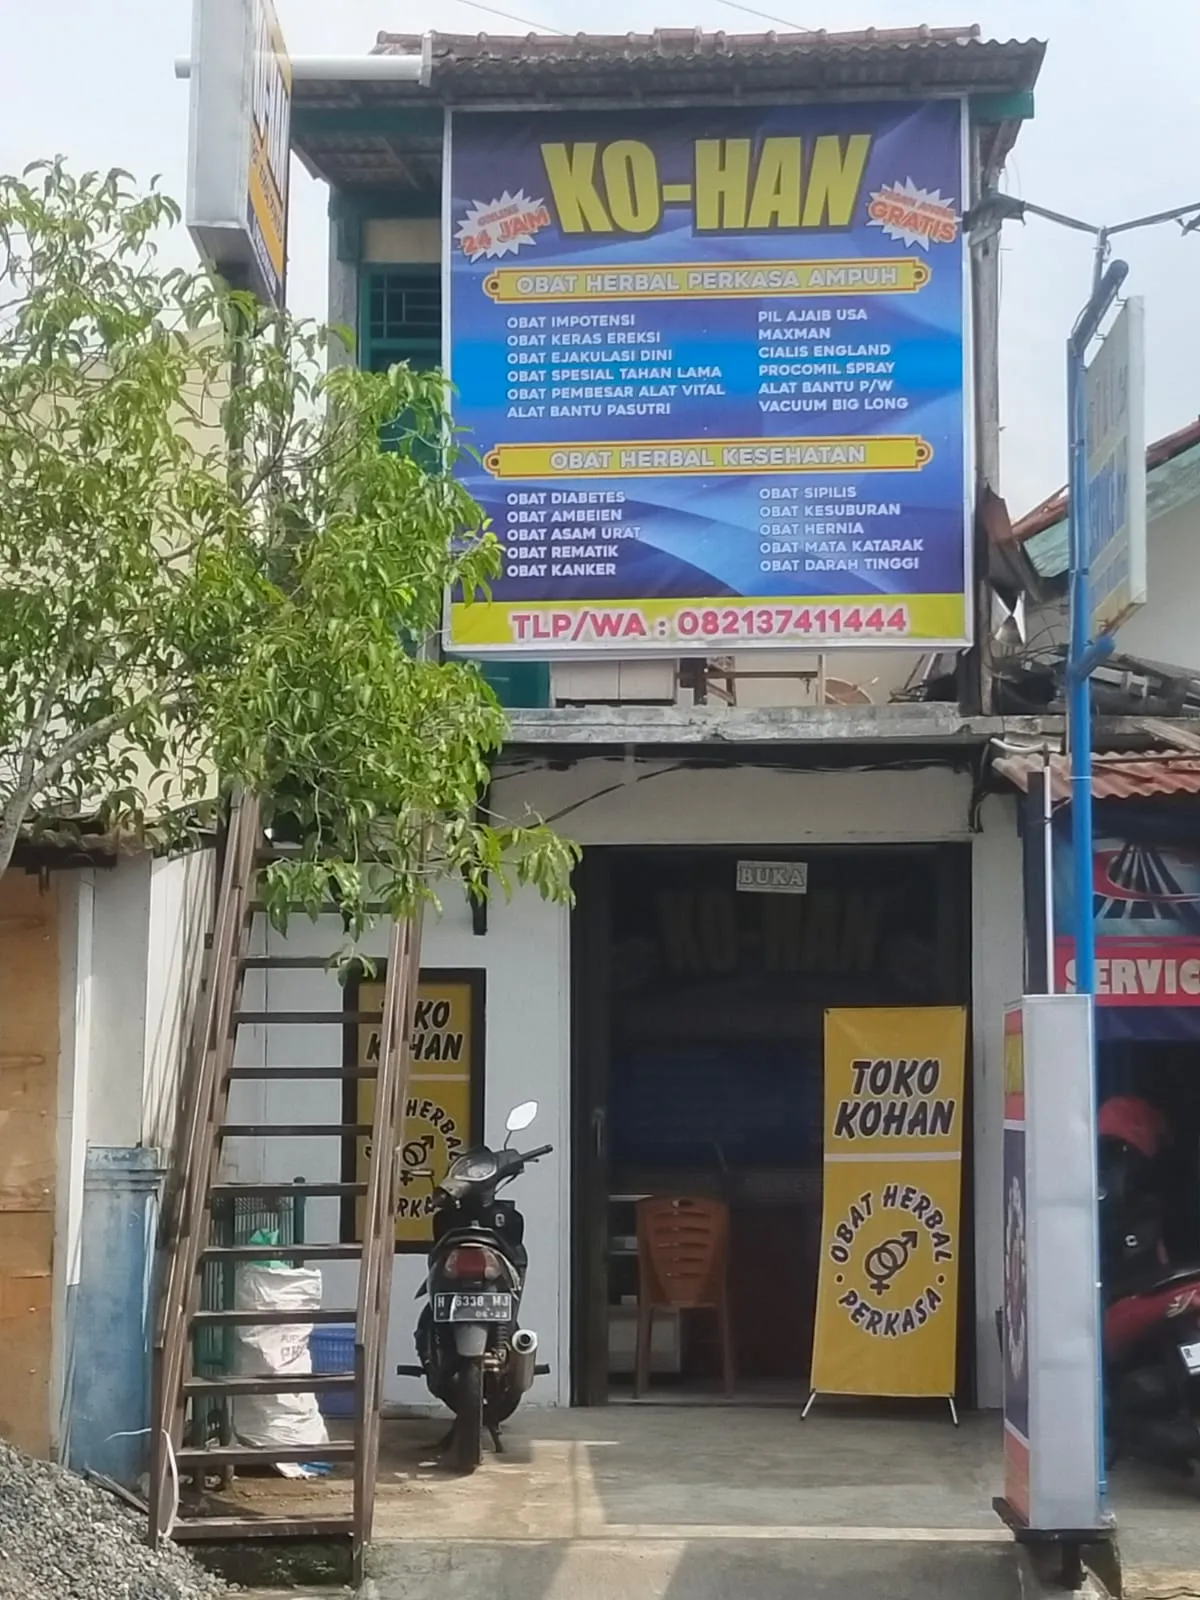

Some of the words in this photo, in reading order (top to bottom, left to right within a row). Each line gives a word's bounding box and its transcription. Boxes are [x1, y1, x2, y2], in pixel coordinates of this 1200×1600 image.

[541, 135, 872, 233] KO-HAN
[870, 200, 956, 242] GRATIS
[462, 229, 492, 255] 24
[497, 206, 550, 243] JAM
[516, 275, 577, 294] OBAT
[585, 272, 679, 292] HERBAL
[688, 270, 799, 290] PERKASA
[808, 267, 897, 287] AMPUH
[507, 316, 546, 329] OBAT
[551, 314, 636, 328] IMPOTENSI
[758, 311, 782, 323] PIL
[786, 310, 832, 322] AJAIB
[836, 308, 868, 321] USA
[507, 334, 546, 347] OBAT
[551, 333, 602, 345] KERAS
[607, 331, 661, 344] EREKSI
[758, 327, 831, 341] MAXMAN
[507, 352, 546, 365] OBAT
[551, 350, 635, 364] EJAKULASI
[640, 349, 673, 361] DINI
[758, 345, 809, 358] CIALIS
[813, 343, 892, 357] ENGLAND
[507, 370, 546, 382] OBAT
[551, 368, 614, 381] SPESIAL
[619, 367, 672, 380] TAHAN
[677, 366, 723, 378] LAMA
[758, 363, 842, 376] PROCOMIL
[846, 361, 896, 374] SPRAY
[507, 388, 546, 400] OBAT
[551, 385, 634, 399] PEMBESAR
[638, 384, 677, 397] ALAT
[681, 383, 726, 396] VITAL
[758, 381, 798, 394] ALAT
[802, 380, 855, 393] BANTU
[860, 379, 894, 393] P/W
[507, 406, 545, 418] ALAT
[550, 404, 602, 417] BANTU
[607, 402, 671, 416] PASUTRI
[758, 399, 827, 412] VACUUM
[832, 398, 860, 411] BIG
[864, 397, 909, 410] LONG
[550, 451, 613, 470] OBAT
[619, 448, 714, 468] HERBAL
[723, 444, 866, 466] KESEHATAN
[507, 493, 547, 505] OBAT
[551, 491, 626, 504] DIABETES
[759, 487, 799, 499] OBAT
[804, 485, 858, 499] SIPILIS
[507, 511, 547, 523] OBAT
[551, 509, 622, 522] AMBEIEN
[759, 505, 799, 518] OBAT
[804, 503, 901, 517] KESUBURAN
[507, 529, 547, 541] OBAT
[551, 527, 597, 541] ASAM
[601, 526, 642, 539] URAT
[759, 523, 799, 536] OBAT
[805, 521, 865, 535] HERNIA
[507, 547, 547, 559] OBAT
[551, 545, 620, 558] REMATIK
[760, 541, 799, 554] OBAT
[805, 540, 847, 553] MATA
[852, 539, 925, 552] KATARAK
[507, 565, 547, 577] OBAT
[551, 562, 617, 577] KANKER
[760, 560, 800, 572] OBAT
[805, 558, 860, 572] DARAH
[863, 557, 919, 570] TINGGI
[512, 610, 647, 641] TLP/WA
[679, 607, 907, 635] 082137411444
[739, 867, 805, 886] BUKA
[366, 1031, 464, 1061] KHAN
[852, 1059, 940, 1098] TOKO
[833, 1100, 955, 1139] KOHAN
[830, 1191, 872, 1263] OBAT
[882, 1184, 953, 1263] HERBAL
[838, 1287, 942, 1337] PERKASA
